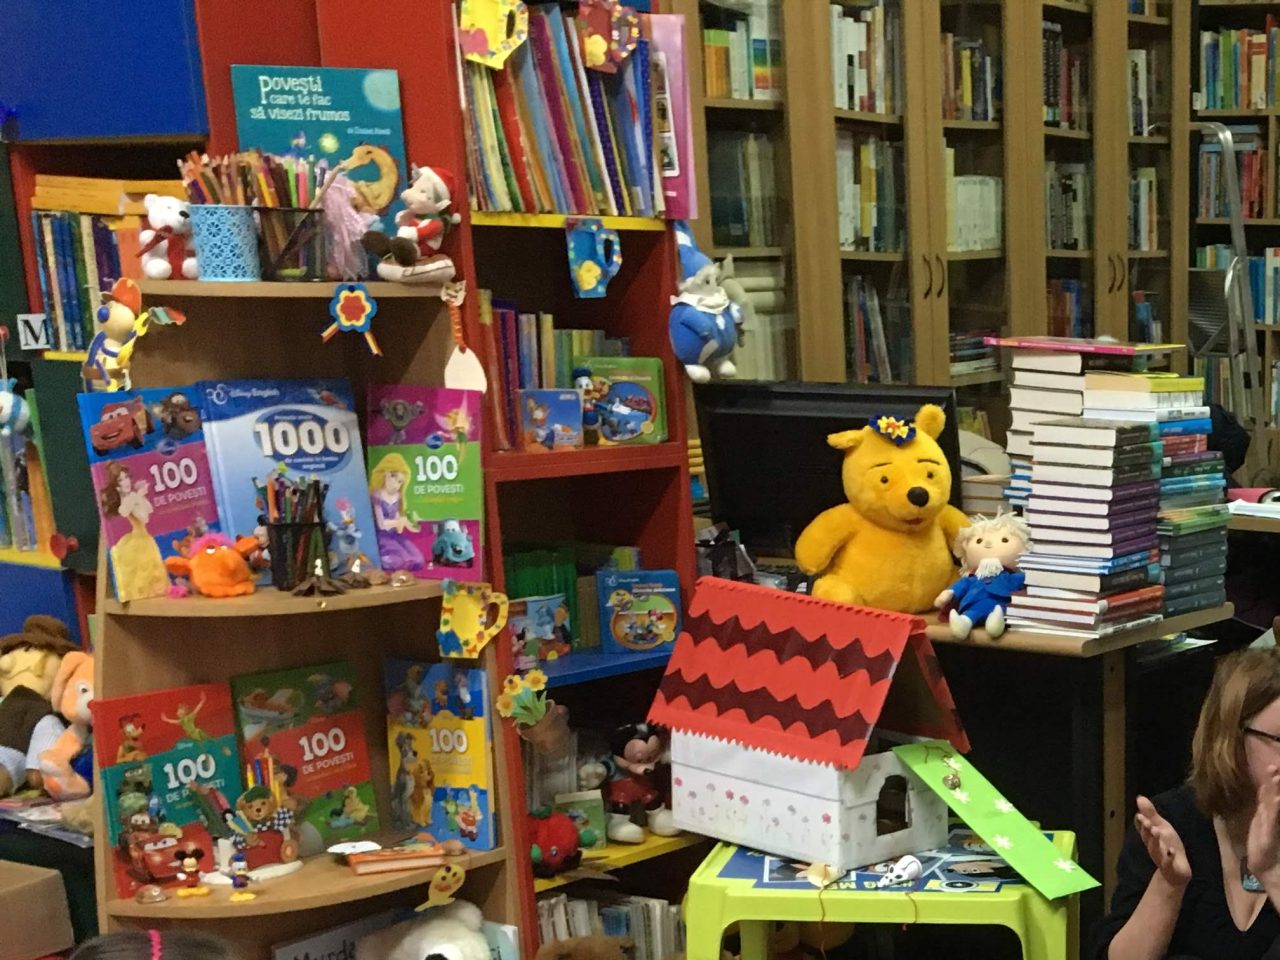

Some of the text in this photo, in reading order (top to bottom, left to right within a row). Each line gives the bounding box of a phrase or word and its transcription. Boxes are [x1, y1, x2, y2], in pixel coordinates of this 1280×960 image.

[21, 319, 51, 346] M
[255, 421, 350, 456] 1000
[149, 458, 198, 492] 100
[415, 454, 458, 481] 100
[299, 727, 346, 761] 100
[428, 728, 468, 752] 100
[163, 753, 216, 789] 100
